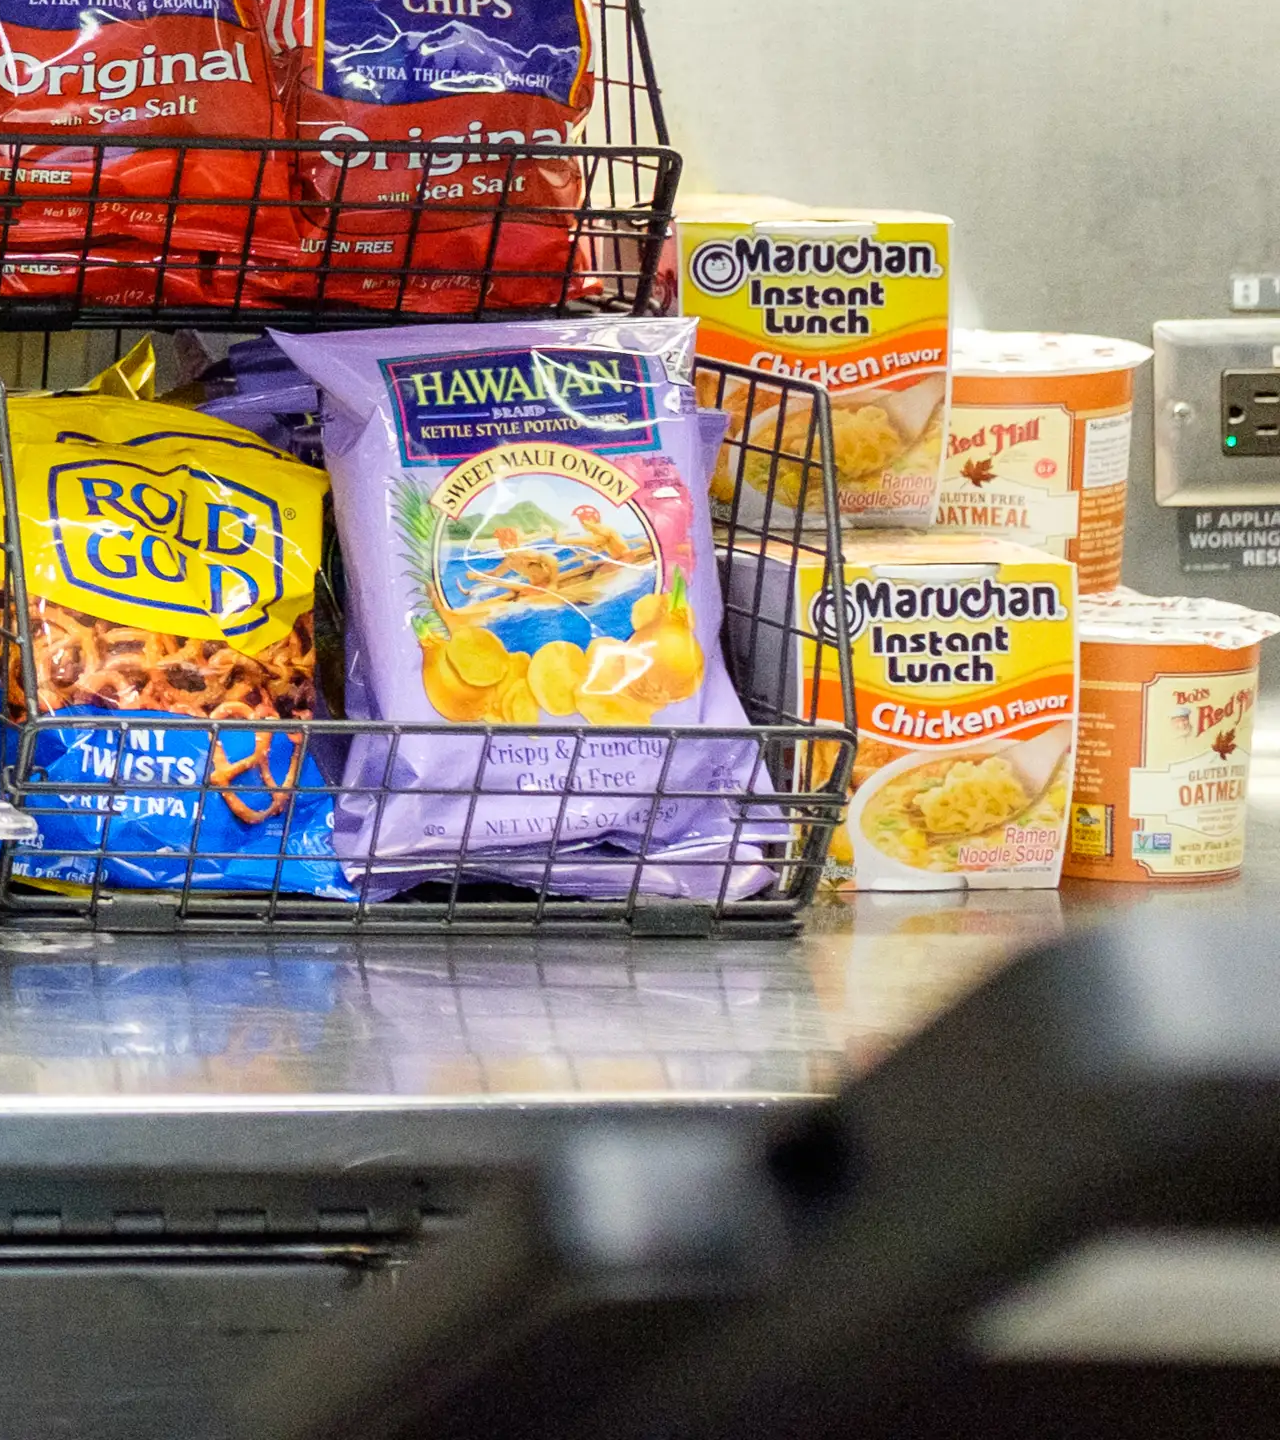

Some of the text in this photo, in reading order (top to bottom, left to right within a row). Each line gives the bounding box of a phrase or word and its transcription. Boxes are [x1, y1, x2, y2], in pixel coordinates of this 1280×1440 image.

[355, 64, 460, 83] EXTRA THICK
[88, 95, 198, 125] Sea Salt
[30, 169, 72, 185] FREE
[377, 192, 410, 202] with
[354, 240, 394, 254] FREE
[735, 235, 932, 274] Maruchan
[751, 280, 884, 308] Instant
[765, 309, 870, 334] Lunch
[882, 347, 941, 371] Flavor
[492, 405, 546, 420] BRAND
[420, 418, 579, 439] KETTLE STYLE POTATO
[990, 417, 1040, 457] Mill
[500, 448, 556, 469] MAUI
[561, 452, 629, 498] ONION
[882, 472, 932, 489] Ramen
[838, 490, 930, 508] Noodle Soup
[991, 494, 1025, 506] FREE
[77, 477, 257, 557] ROLD
[1190, 532, 1280, 548] WORKING
[86, 528, 260, 615] GOLD
[856, 579, 1057, 618] Maruchan
[873, 625, 1009, 656] Instant
[889, 655, 993, 683] Lunch
[871, 695, 1069, 740] Chicken Flavor
[80, 743, 197, 786] TWISTS
[487, 744, 549, 767] Crispy
[1188, 765, 1227, 781] GLUTEN
[1005, 827, 1057, 844] Ramen
[958, 846, 1010, 864] Noodle
[1015, 845, 1054, 863] Soup
